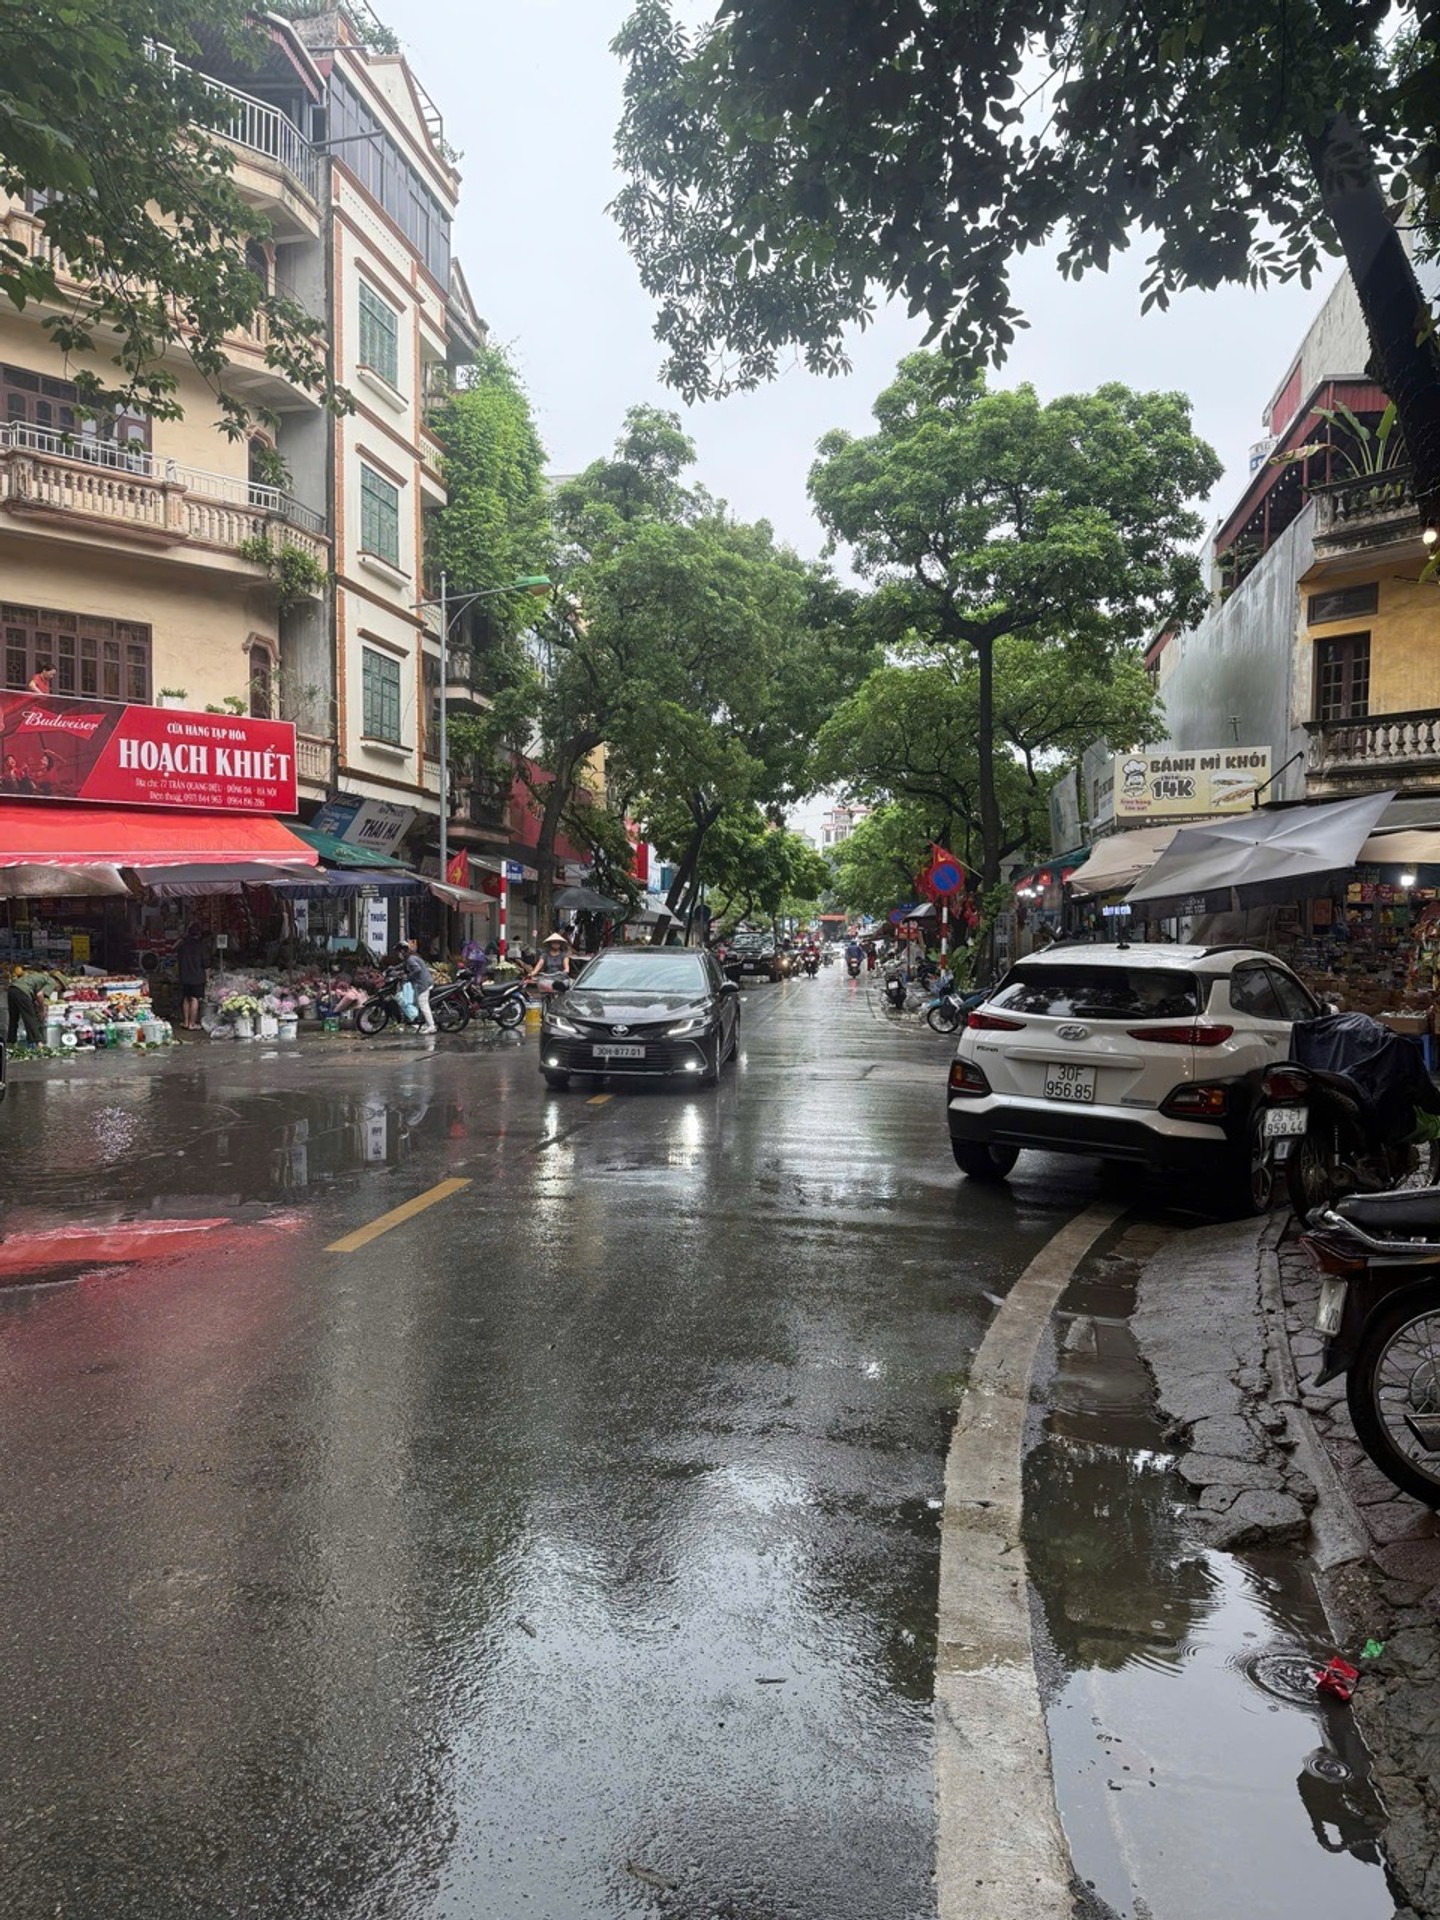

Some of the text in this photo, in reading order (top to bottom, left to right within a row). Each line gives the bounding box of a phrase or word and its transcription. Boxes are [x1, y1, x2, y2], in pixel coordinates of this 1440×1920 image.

[22, 710, 99, 730] Budweiser
[118, 738, 291, 781] HOẠCH KHIẾT
[1150, 756, 1196, 774] BÁNH
[1200, 753, 1221, 770] MÌ
[1152, 779, 1193, 798] 14K
[1057, 1065, 1085, 1082] 30F
[1046, 1081, 1093, 1100] 956.85
